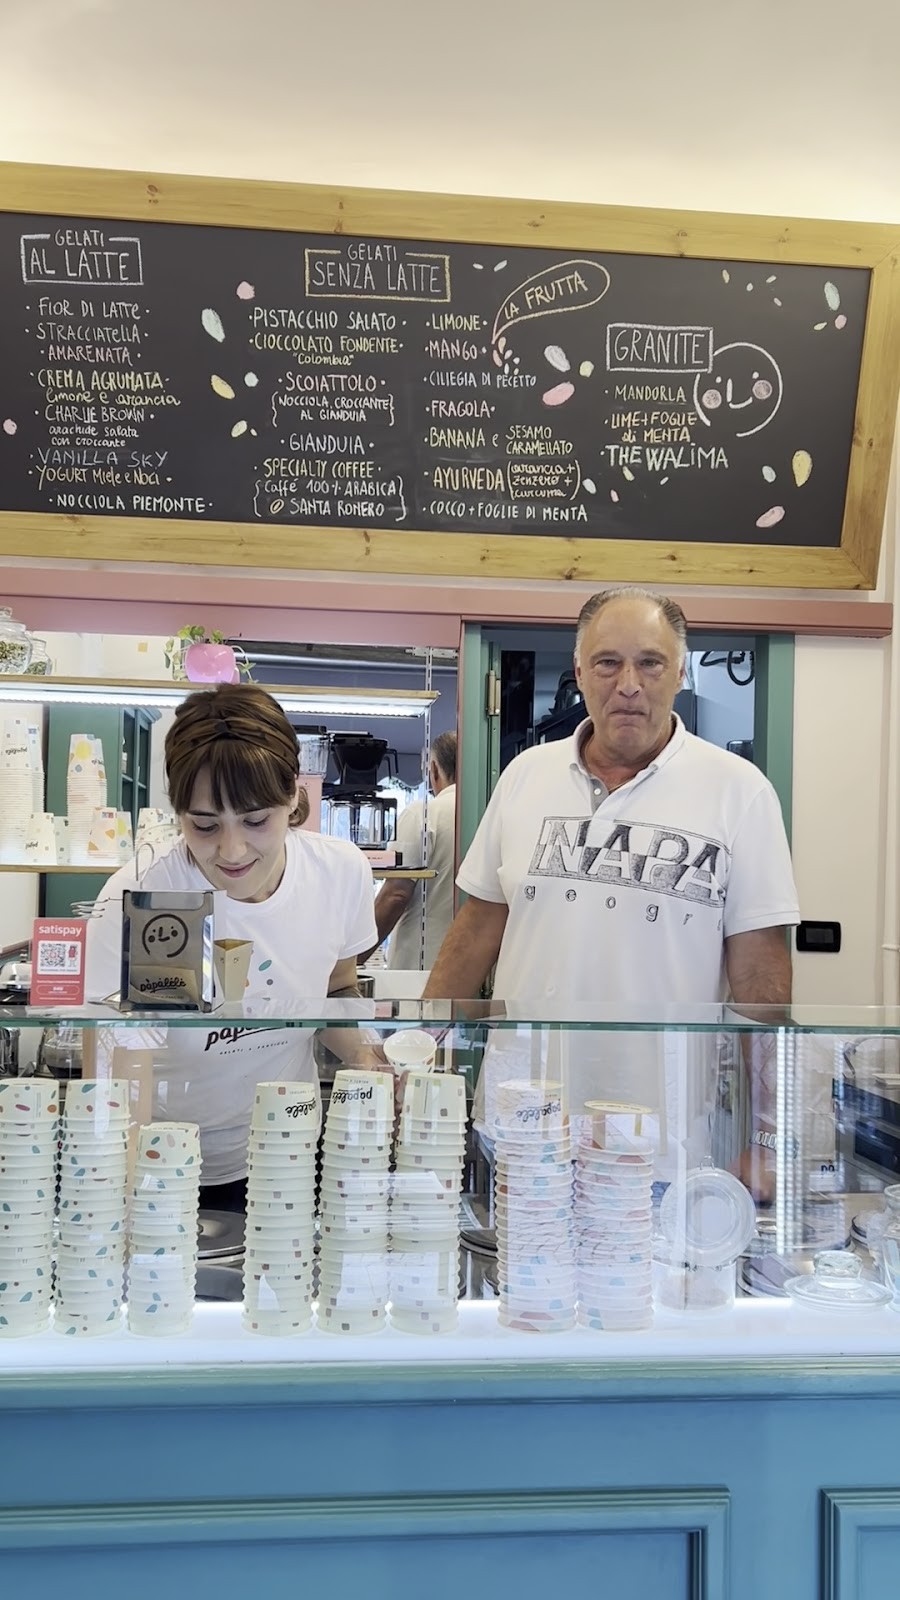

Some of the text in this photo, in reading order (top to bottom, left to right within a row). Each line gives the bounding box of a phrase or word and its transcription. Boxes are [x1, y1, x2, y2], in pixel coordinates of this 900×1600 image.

[55, 229, 104, 247] GELATI
[347, 243, 397, 261] GELATI
[31, 248, 130, 281] AL LATTE
[312, 261, 441, 293] SENZA LATTE
[504, 270, 588, 320] LA FRUTTA
[39, 297, 74, 316] FIOR
[81, 300, 94, 318] DI
[253, 307, 396, 331] PISTACCHIO SALATO
[431, 313, 481, 331] LIMONE
[254, 332, 399, 354] CIOCCOLATO FONDENTE
[429, 339, 478, 360] MANGO
[614, 329, 705, 365] GRANITE
[48, 344, 133, 367] AMARENATA
[38, 369, 163, 392] CREMA AGRUMATA
[285, 371, 377, 392] SCOIATTOLO
[429, 370, 536, 389] CILIEGIA DI PECETTO
[99, 391, 109, 404] e
[115, 393, 181, 406] arancia
[615, 384, 687, 402] MANDORLA
[334, 396, 390, 410] CROCCANTE
[431, 400, 491, 418] FRAGOLA
[45, 404, 145, 424] CHARLIE BROWN
[300, 408, 367, 422] AL GIANDUIA
[49, 424, 139, 438] arachide salata
[430, 426, 499, 449] BANANA e
[505, 425, 552, 440] SESAMO
[622, 427, 690, 443] di MENTA
[52, 437, 126, 447] con croccante
[289, 433, 365, 455] GIANDUIA
[37, 448, 168, 468] VANILLA SKY
[605, 445, 642, 467] THE
[35, 465, 88, 491] YOGURT
[124, 471, 131, 484] e
[263, 458, 375, 479] SPECIALTY COFFEE
[344, 480, 397, 497] ARABICA
[433, 466, 505, 492] AYURVEDA
[512, 475, 559, 486] zenzero
[514, 488, 567, 498] curcuma
[56, 494, 205, 513] NOCCIOLA PIEMONTE
[290, 498, 331, 516] SANTA
[526, 507, 536, 519] DI
[542, 504, 588, 522] MENTA
[39, 924, 82, 937] satispay
